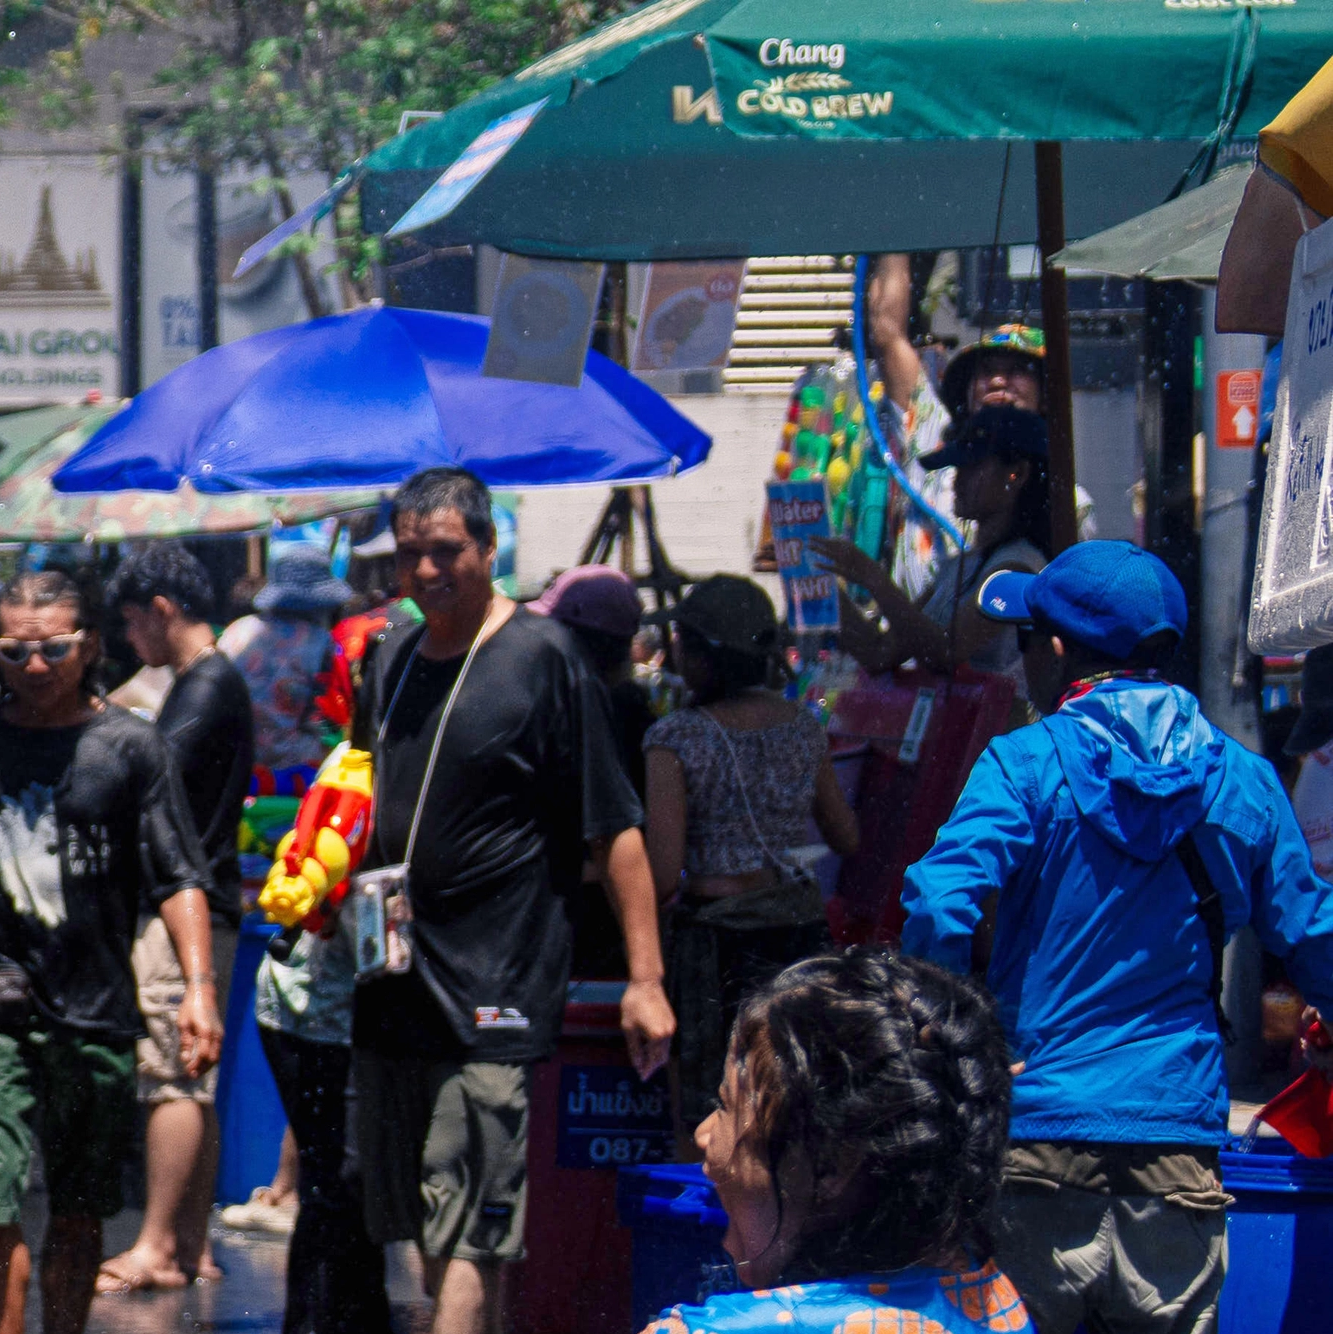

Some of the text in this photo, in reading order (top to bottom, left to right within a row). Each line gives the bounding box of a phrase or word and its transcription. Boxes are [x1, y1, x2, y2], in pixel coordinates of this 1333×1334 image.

[759, 37, 846, 69] Chang
[737, 89, 809, 118] COLD
[812, 91, 894, 119] BREW
